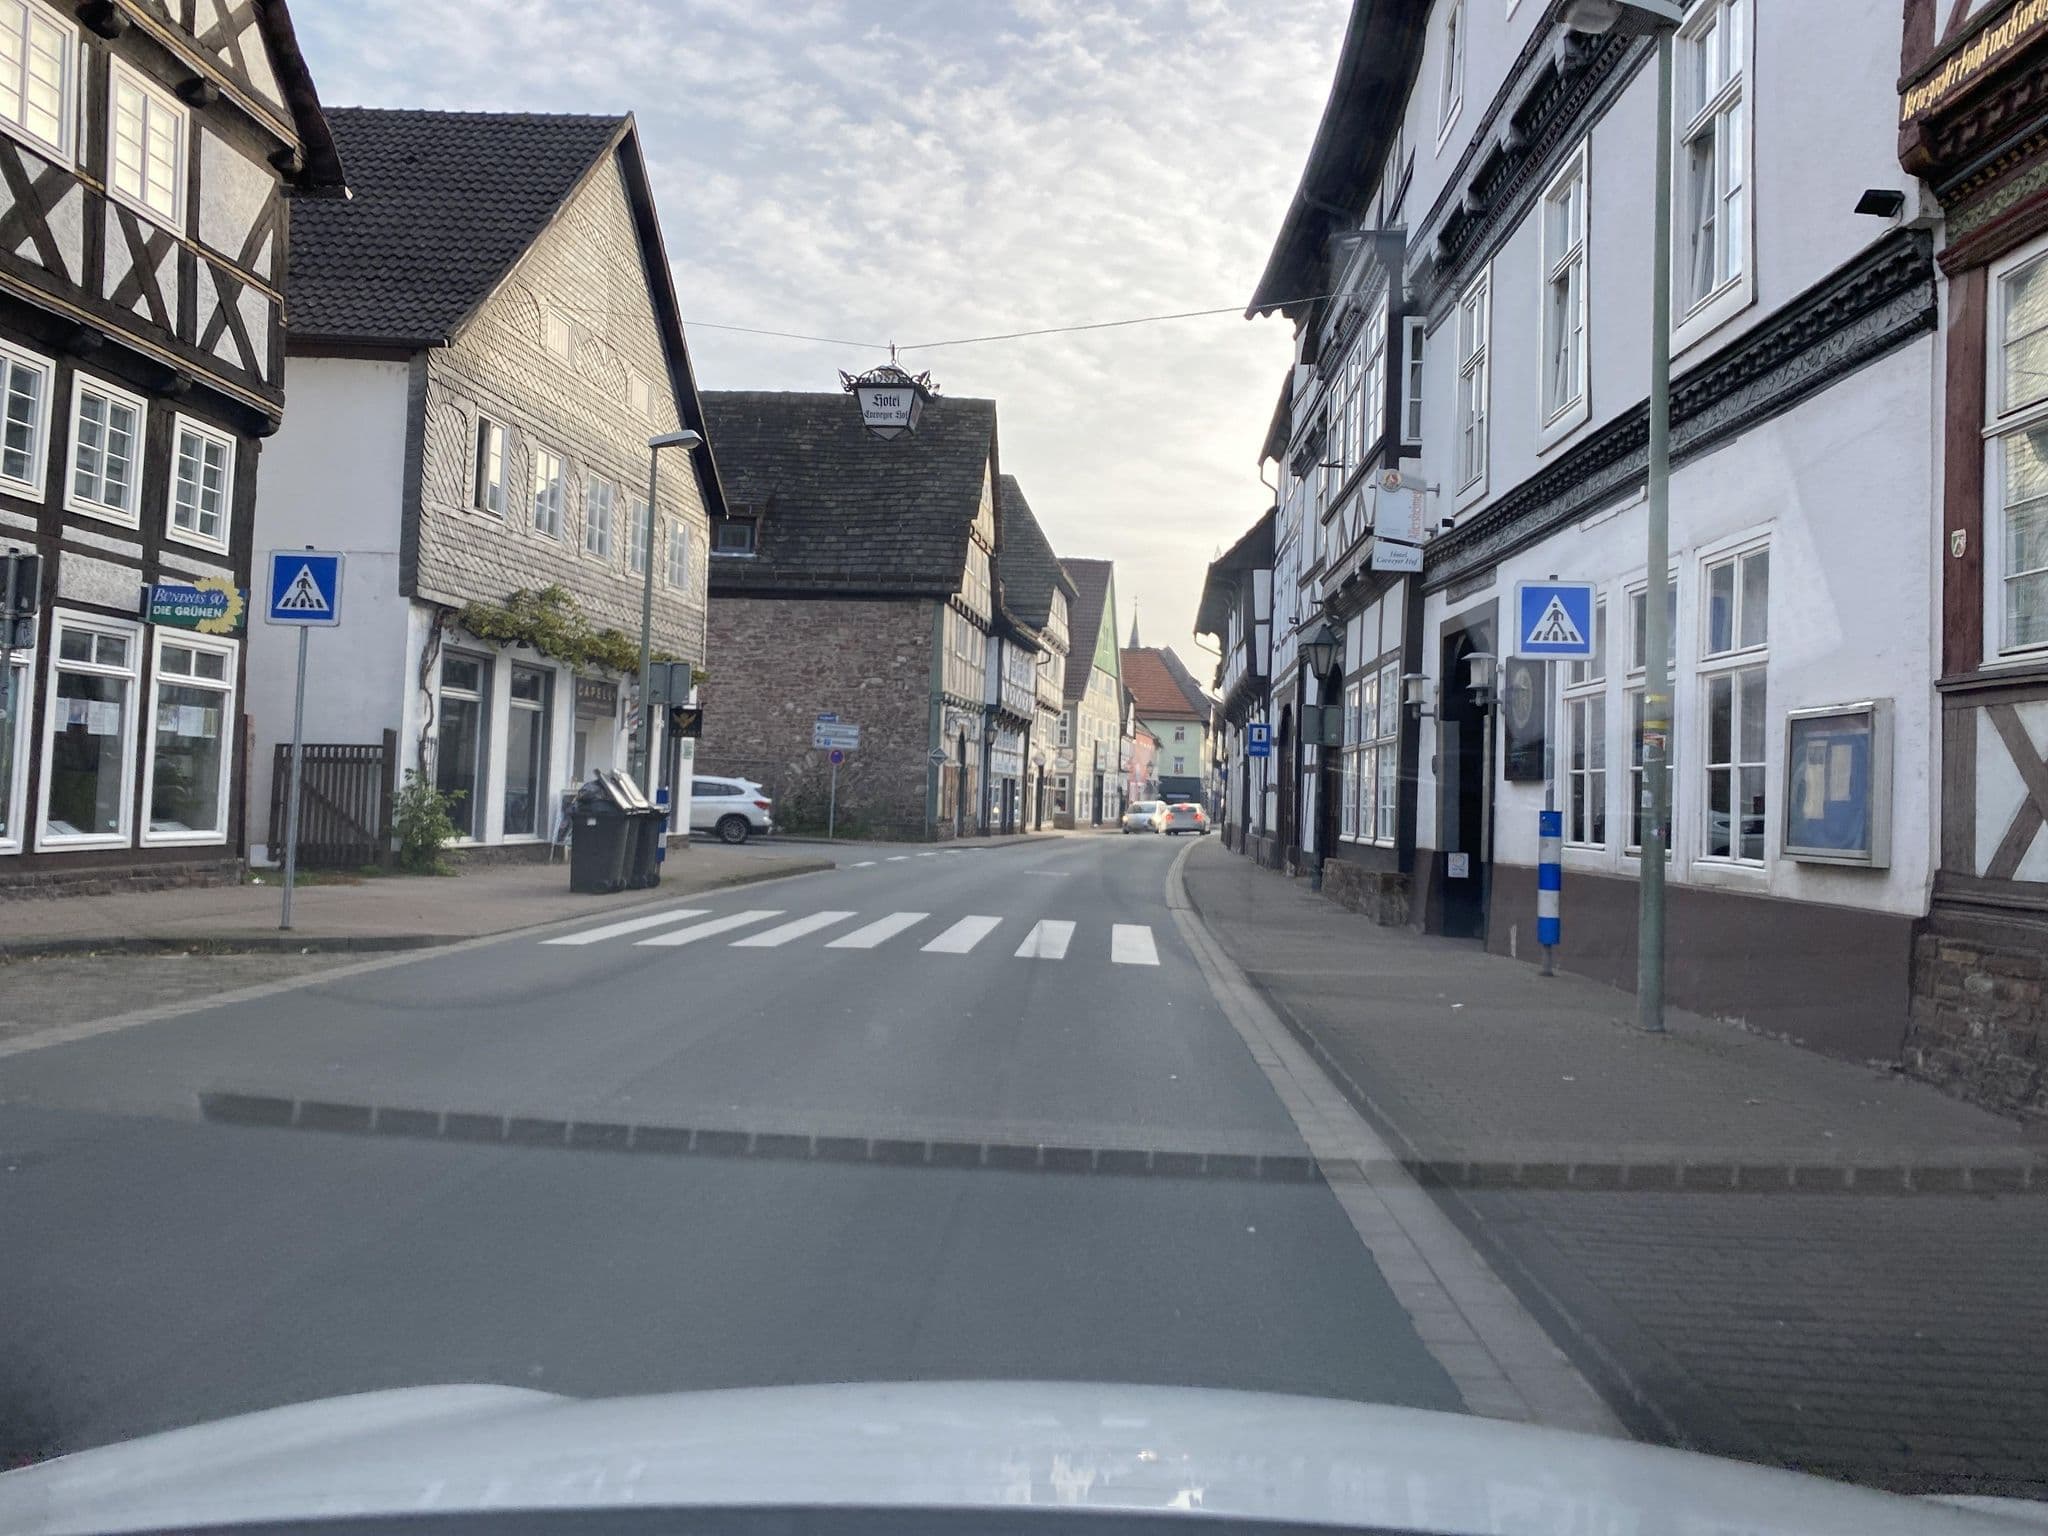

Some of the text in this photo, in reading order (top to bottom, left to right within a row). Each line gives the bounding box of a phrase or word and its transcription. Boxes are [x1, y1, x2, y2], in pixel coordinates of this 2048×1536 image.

[872, 394, 900, 408] Hotel
[895, 410, 909, 420] Hof
[1390, 550, 1408, 558] Hotel
[1403, 557, 1418, 567] Hof
[209, 595, 224, 605] 90
[153, 605, 222, 617] DIE GRÜNEN
